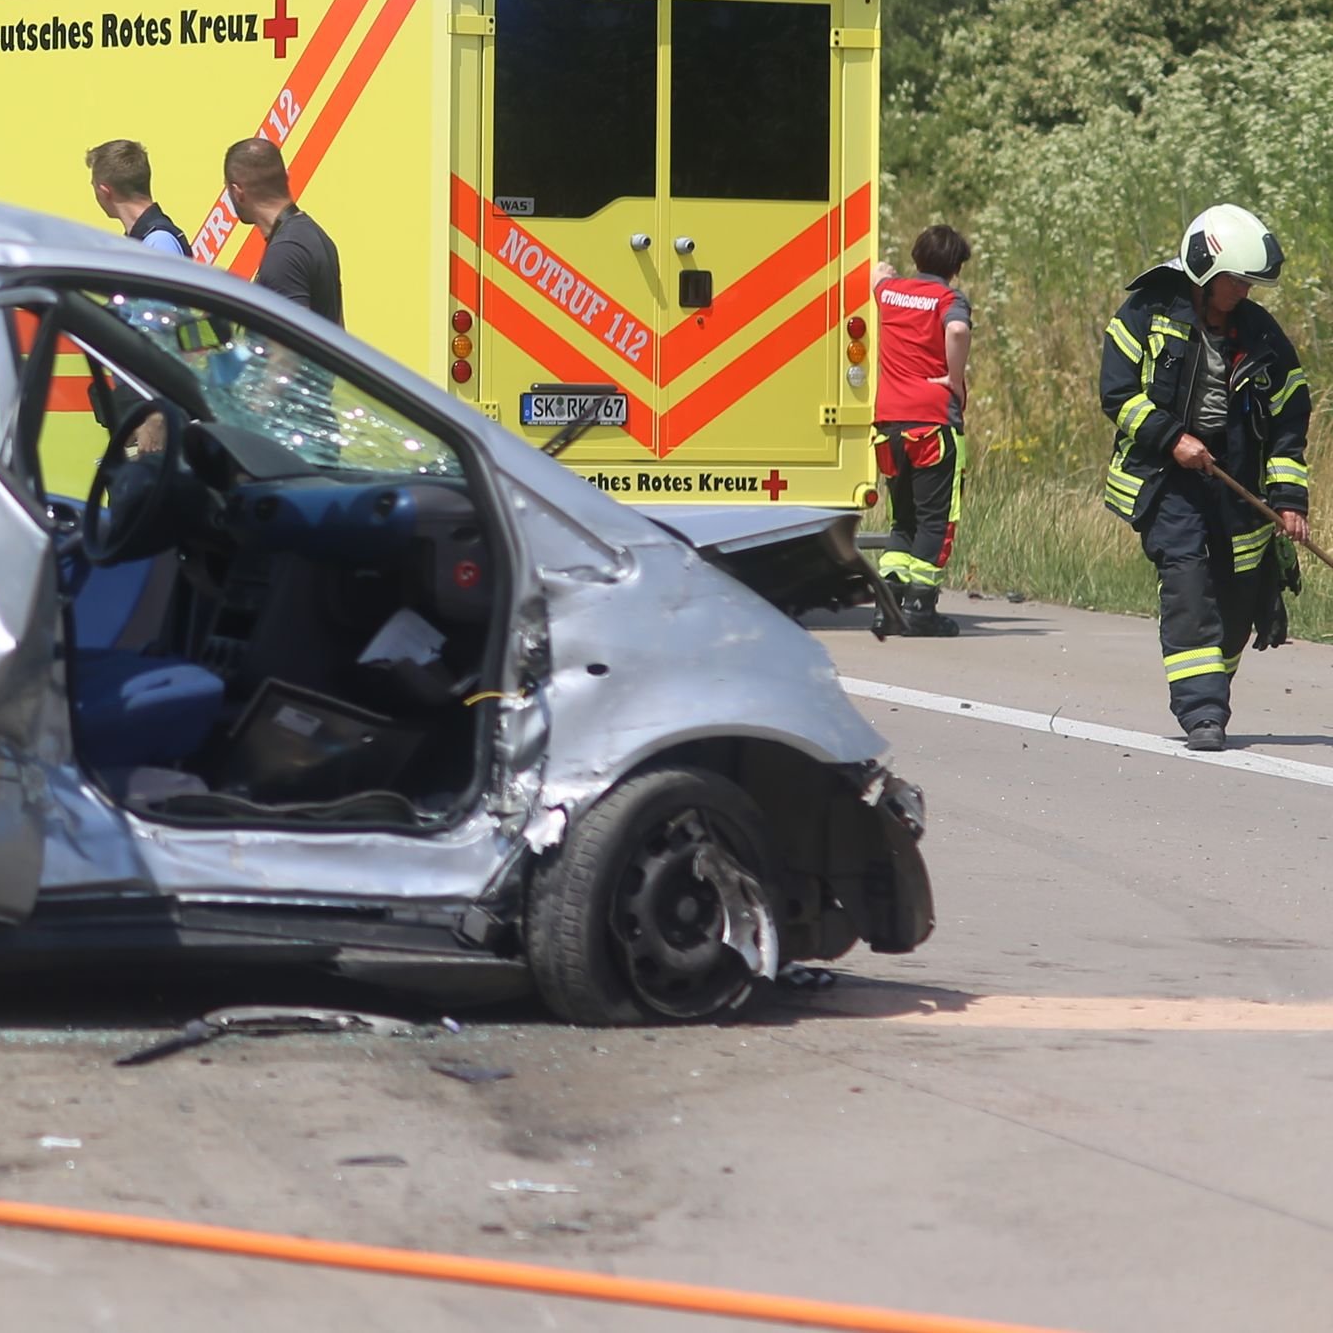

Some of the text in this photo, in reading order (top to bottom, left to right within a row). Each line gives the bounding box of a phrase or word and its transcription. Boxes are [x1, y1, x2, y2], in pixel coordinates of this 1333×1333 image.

[102, 12, 172, 48] Rotes
[180, 9, 258, 45] Kreuz
[500, 200, 528, 211] WAS
[498, 227, 648, 363] NOTRUF 112
[534, 397, 624, 418] SK RK 767
[637, 473, 693, 492] Rotes
[699, 473, 758, 492] Kreuz
